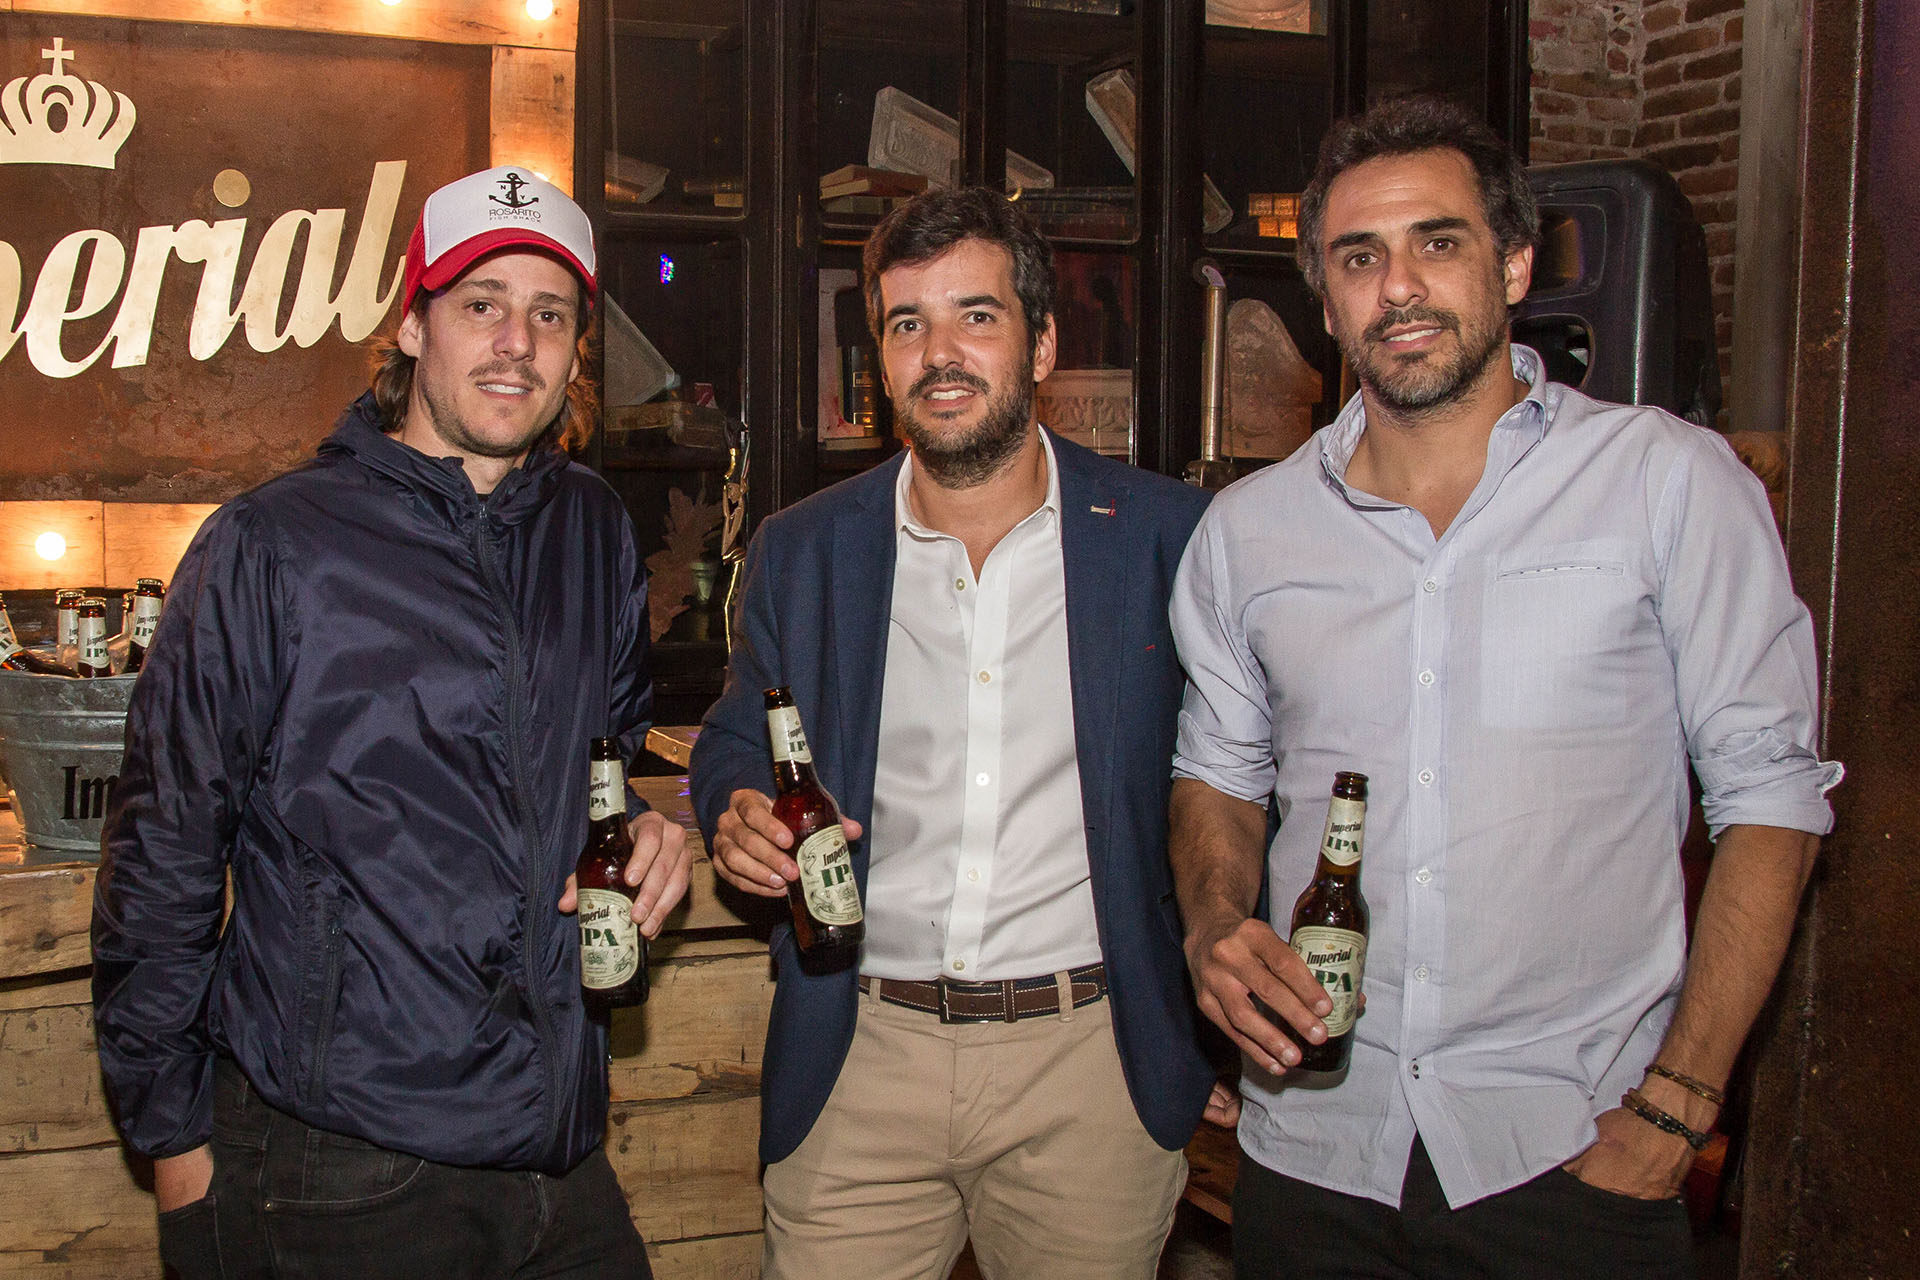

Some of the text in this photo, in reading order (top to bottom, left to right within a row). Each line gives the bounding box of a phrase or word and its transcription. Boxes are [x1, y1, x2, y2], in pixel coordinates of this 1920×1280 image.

[489, 208, 541, 219] ROSARITO
[135, 626, 154, 637] IP
[790, 740, 806, 752] IP
[590, 797, 610, 808] PA
[1327, 835, 1358, 852] IPA
[821, 864, 852, 888] IP
[1306, 948, 1352, 967] Imperial
[1311, 969, 1352, 992] PA
